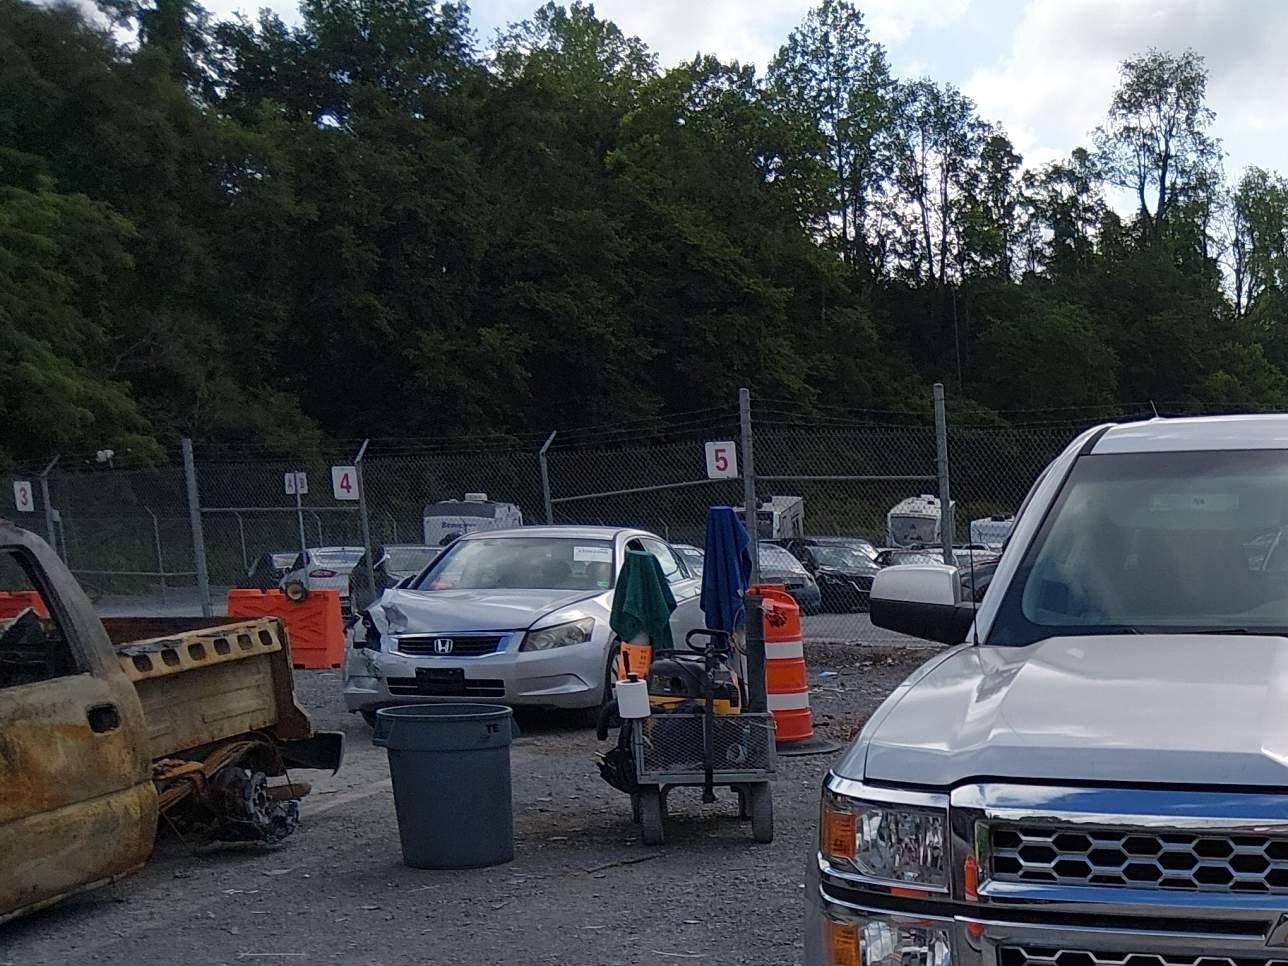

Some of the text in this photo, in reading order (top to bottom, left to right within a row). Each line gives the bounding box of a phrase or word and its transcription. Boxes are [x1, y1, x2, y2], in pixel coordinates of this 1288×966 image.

[714, 448, 729, 472] 5
[340, 473, 352, 494] 4
[20, 487, 28, 506] 3
